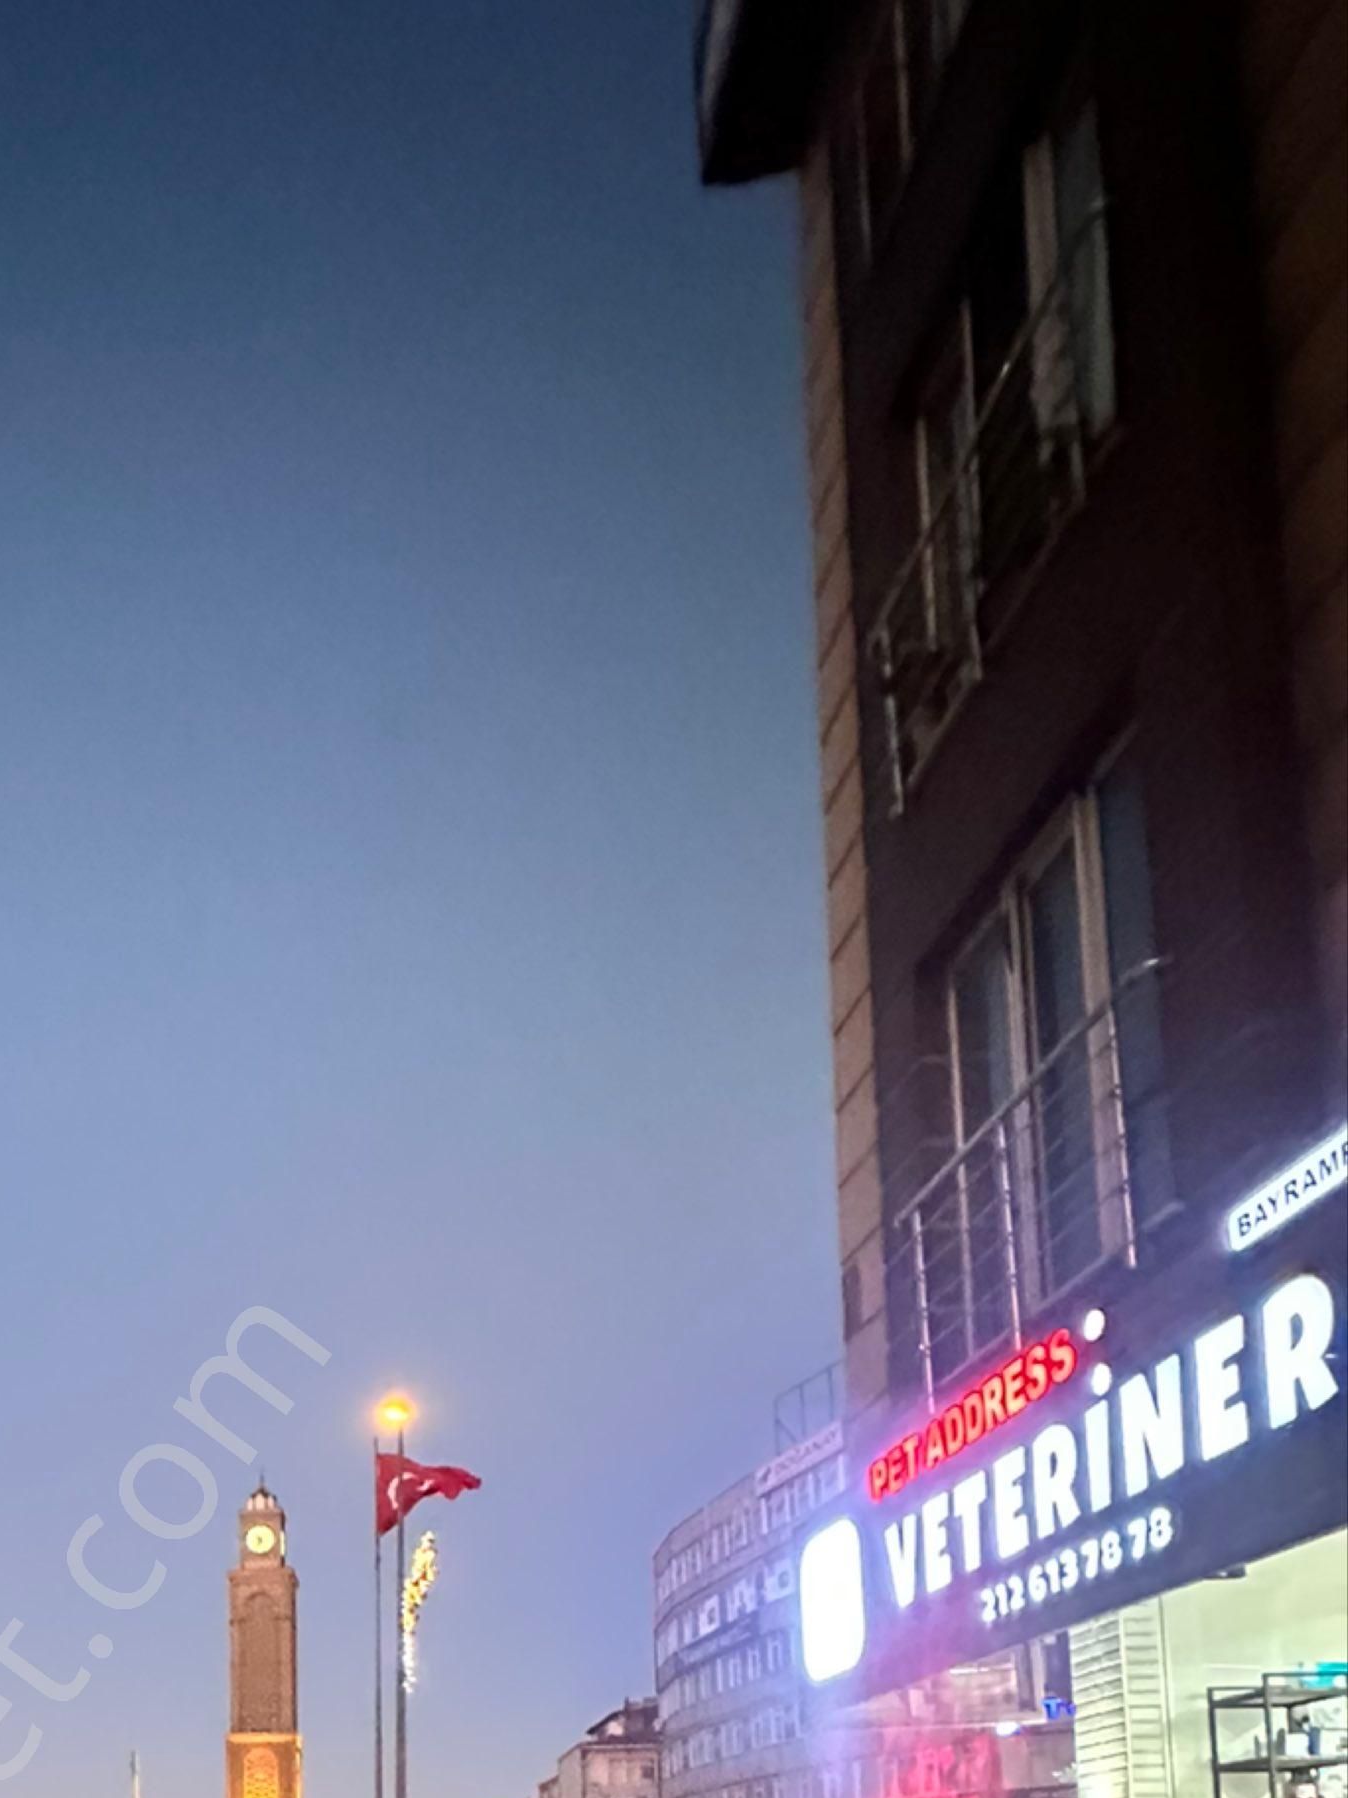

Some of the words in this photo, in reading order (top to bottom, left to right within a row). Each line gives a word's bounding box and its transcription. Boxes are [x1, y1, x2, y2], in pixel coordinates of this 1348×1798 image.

[869, 1432, 920, 1503] PET
[924, 1327, 1077, 1469] ADDRESS
[884, 1273, 1339, 1609] VETERİNER
[980, 1574, 1026, 1623] 212
[1028, 1548, 1079, 1602] 613
[1080, 1530, 1123, 1579] 78
[1127, 1507, 1174, 1559] 78
